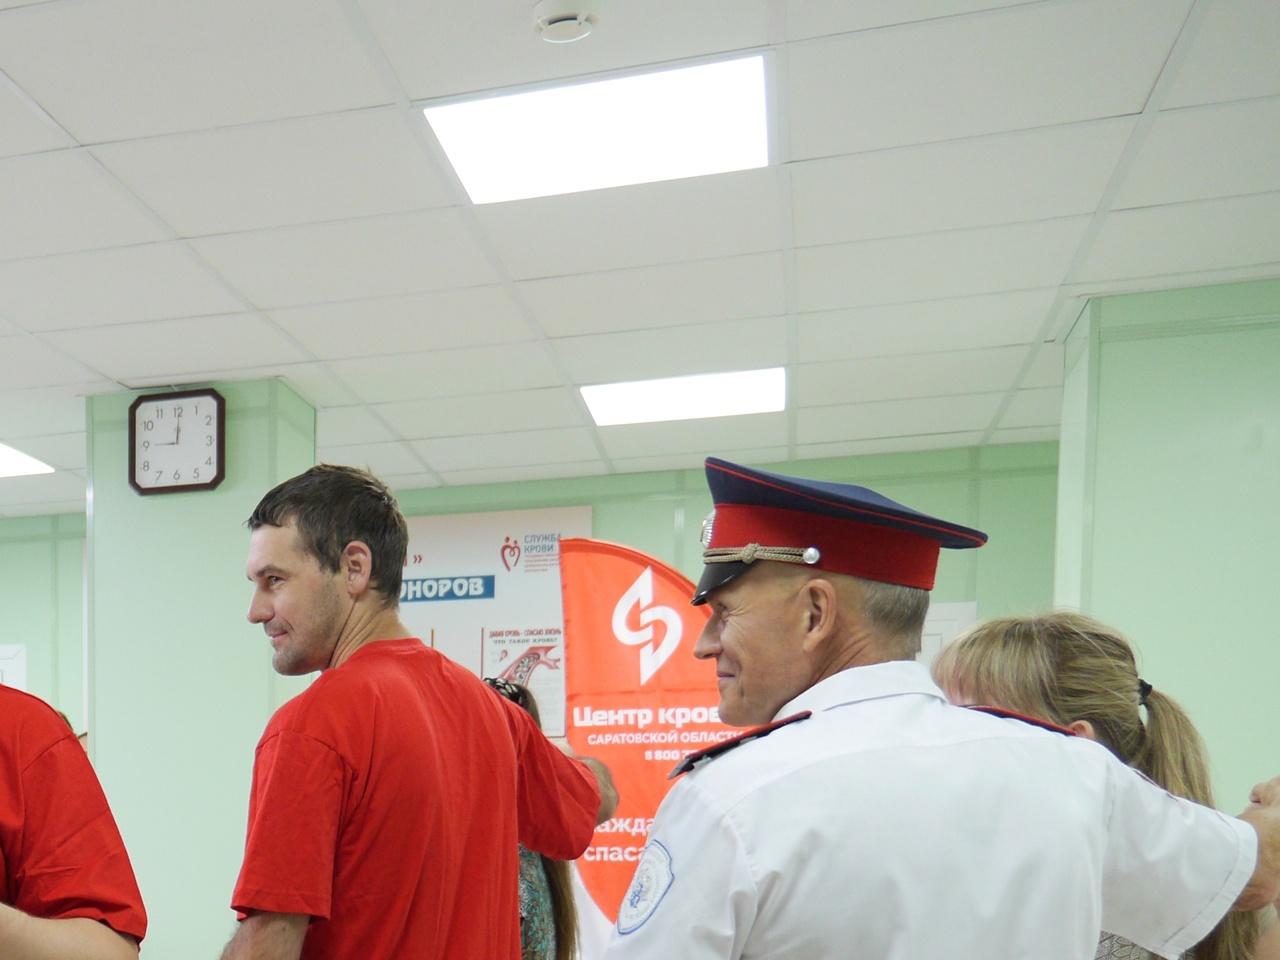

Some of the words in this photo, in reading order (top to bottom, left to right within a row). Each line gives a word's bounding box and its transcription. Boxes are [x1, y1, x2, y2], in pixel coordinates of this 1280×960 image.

[156, 408, 163, 419] 11
[173, 407, 183, 418] 12
[194, 405, 199, 416] 1
[143, 420, 154, 431] 10
[205, 415, 212, 426] 2
[143, 440, 150, 451] 9
[206, 435, 213, 446] 3
[143, 461, 150, 471] 8
[205, 456, 212, 466] 4
[156, 470, 163, 482] 7
[173, 469, 180, 480] 6
[193, 468, 200, 479] 5
[524, 544, 554, 553] КРОВИ
[573, 706, 653, 728] Центр
[658, 707, 722, 728] кров
[587, 730, 677, 745] САРАТОВСКОЙ
[654, 749, 680, 760] 800
